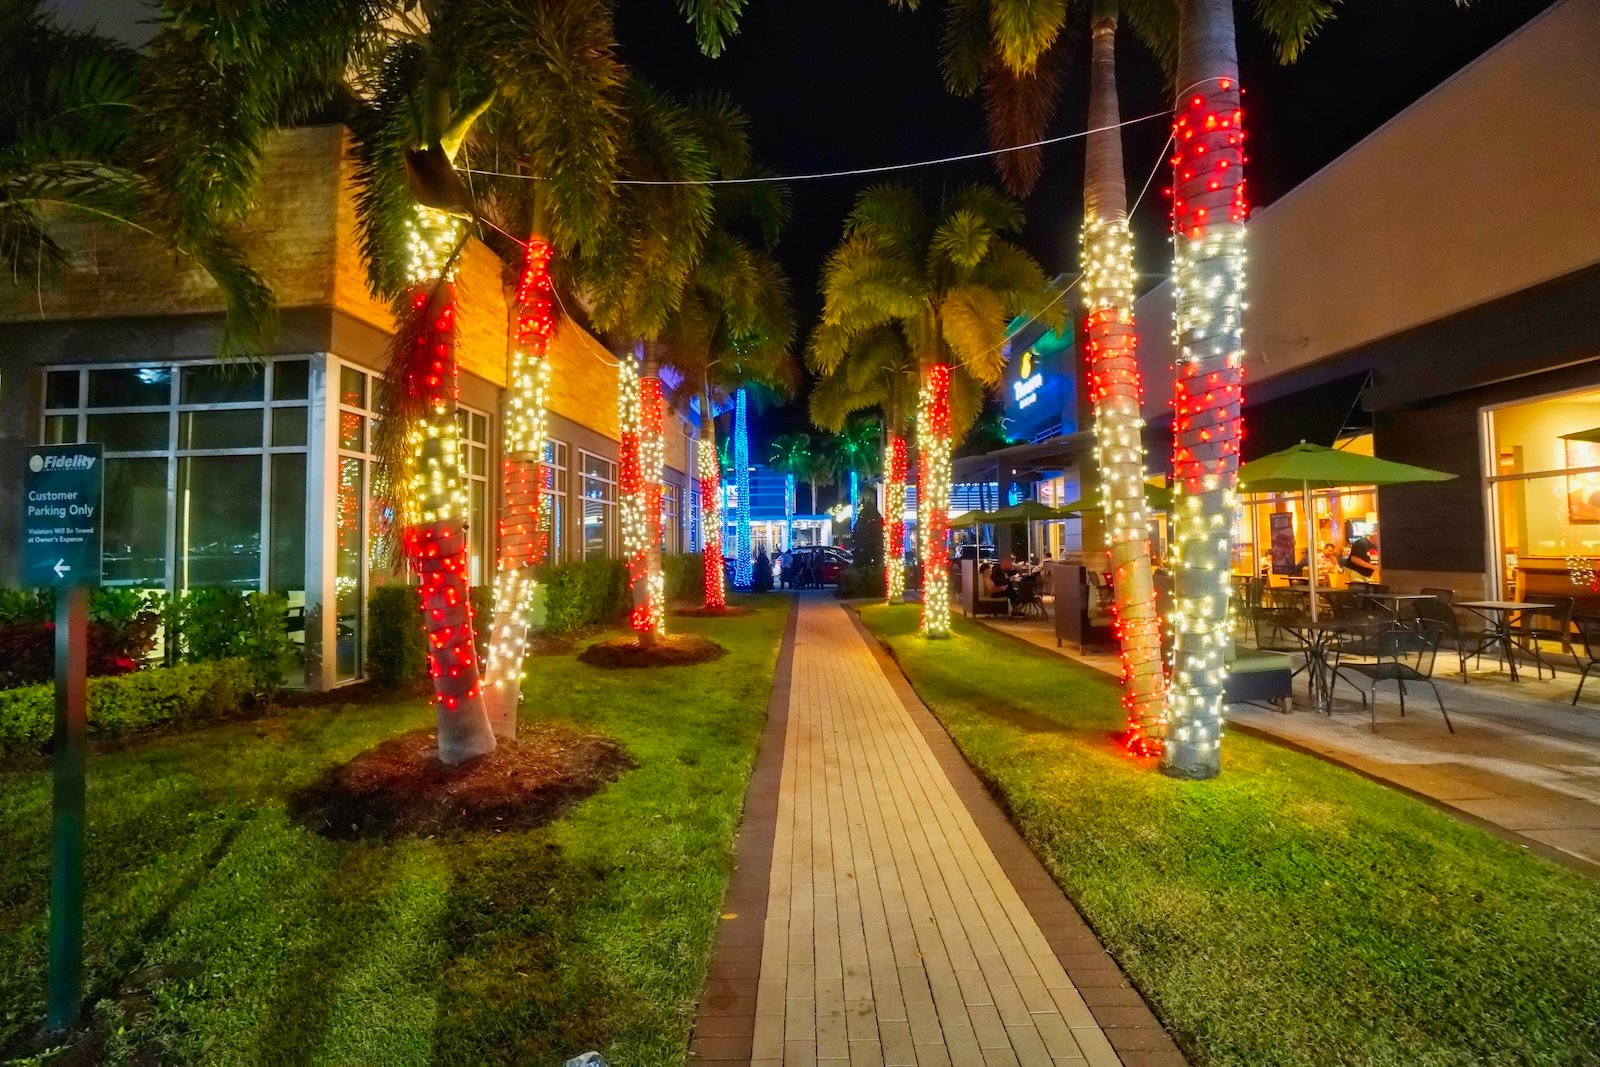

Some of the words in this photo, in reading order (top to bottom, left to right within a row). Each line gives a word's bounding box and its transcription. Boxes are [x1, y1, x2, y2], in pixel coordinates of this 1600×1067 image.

[43, 454, 96, 470] Fidelity
[28, 490, 78, 501] Customer
[28, 504, 66, 518] Parking
[69, 503, 94, 518] Only
[75, 526, 94, 534] Towed
[59, 535, 84, 544] Expense
